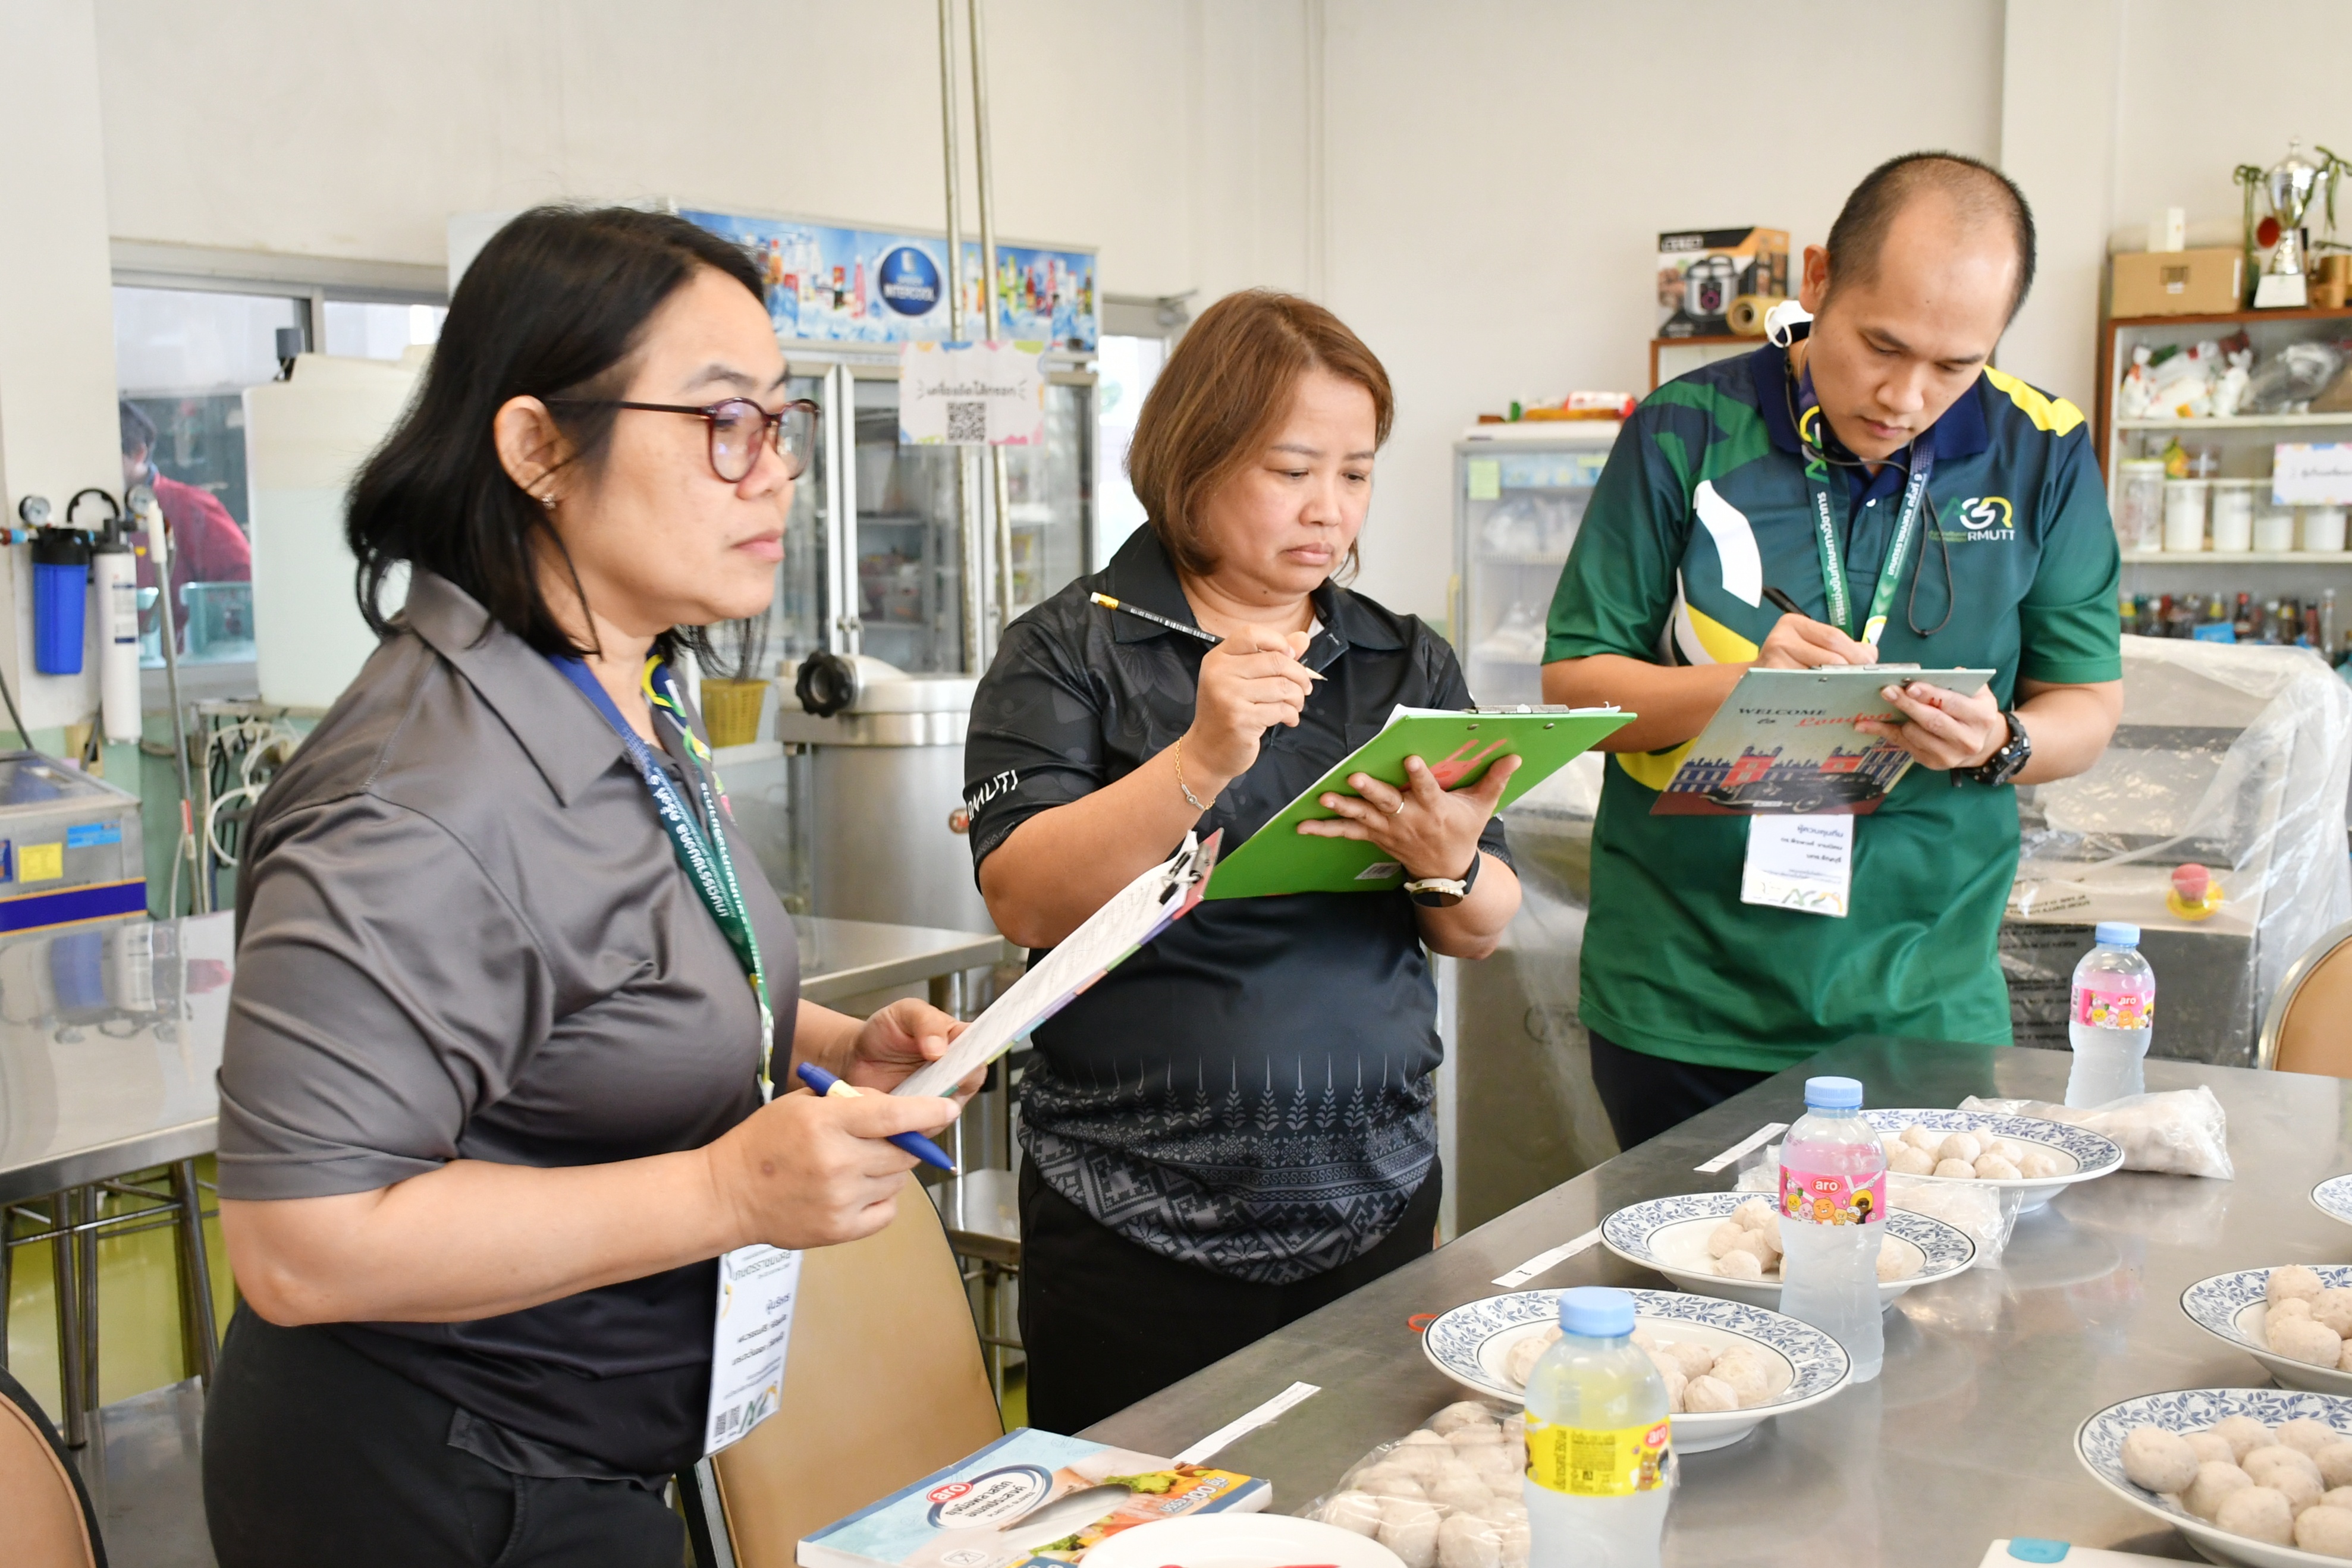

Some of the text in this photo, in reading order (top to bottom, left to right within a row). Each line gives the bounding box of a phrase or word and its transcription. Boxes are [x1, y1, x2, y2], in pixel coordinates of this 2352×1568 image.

[1967, 529, 2015, 542] RMUTT
[1739, 708, 1827, 716] WELCOME
[1794, 712, 1894, 727] London
[1815, 1180, 1838, 1190] aro
[1648, 1425, 1667, 1444] aro
[932, 1484, 967, 1501] aro
[944, 1479, 1013, 1516] ถุงมือพลาสติก
[1182, 1485, 1218, 1501] 100
